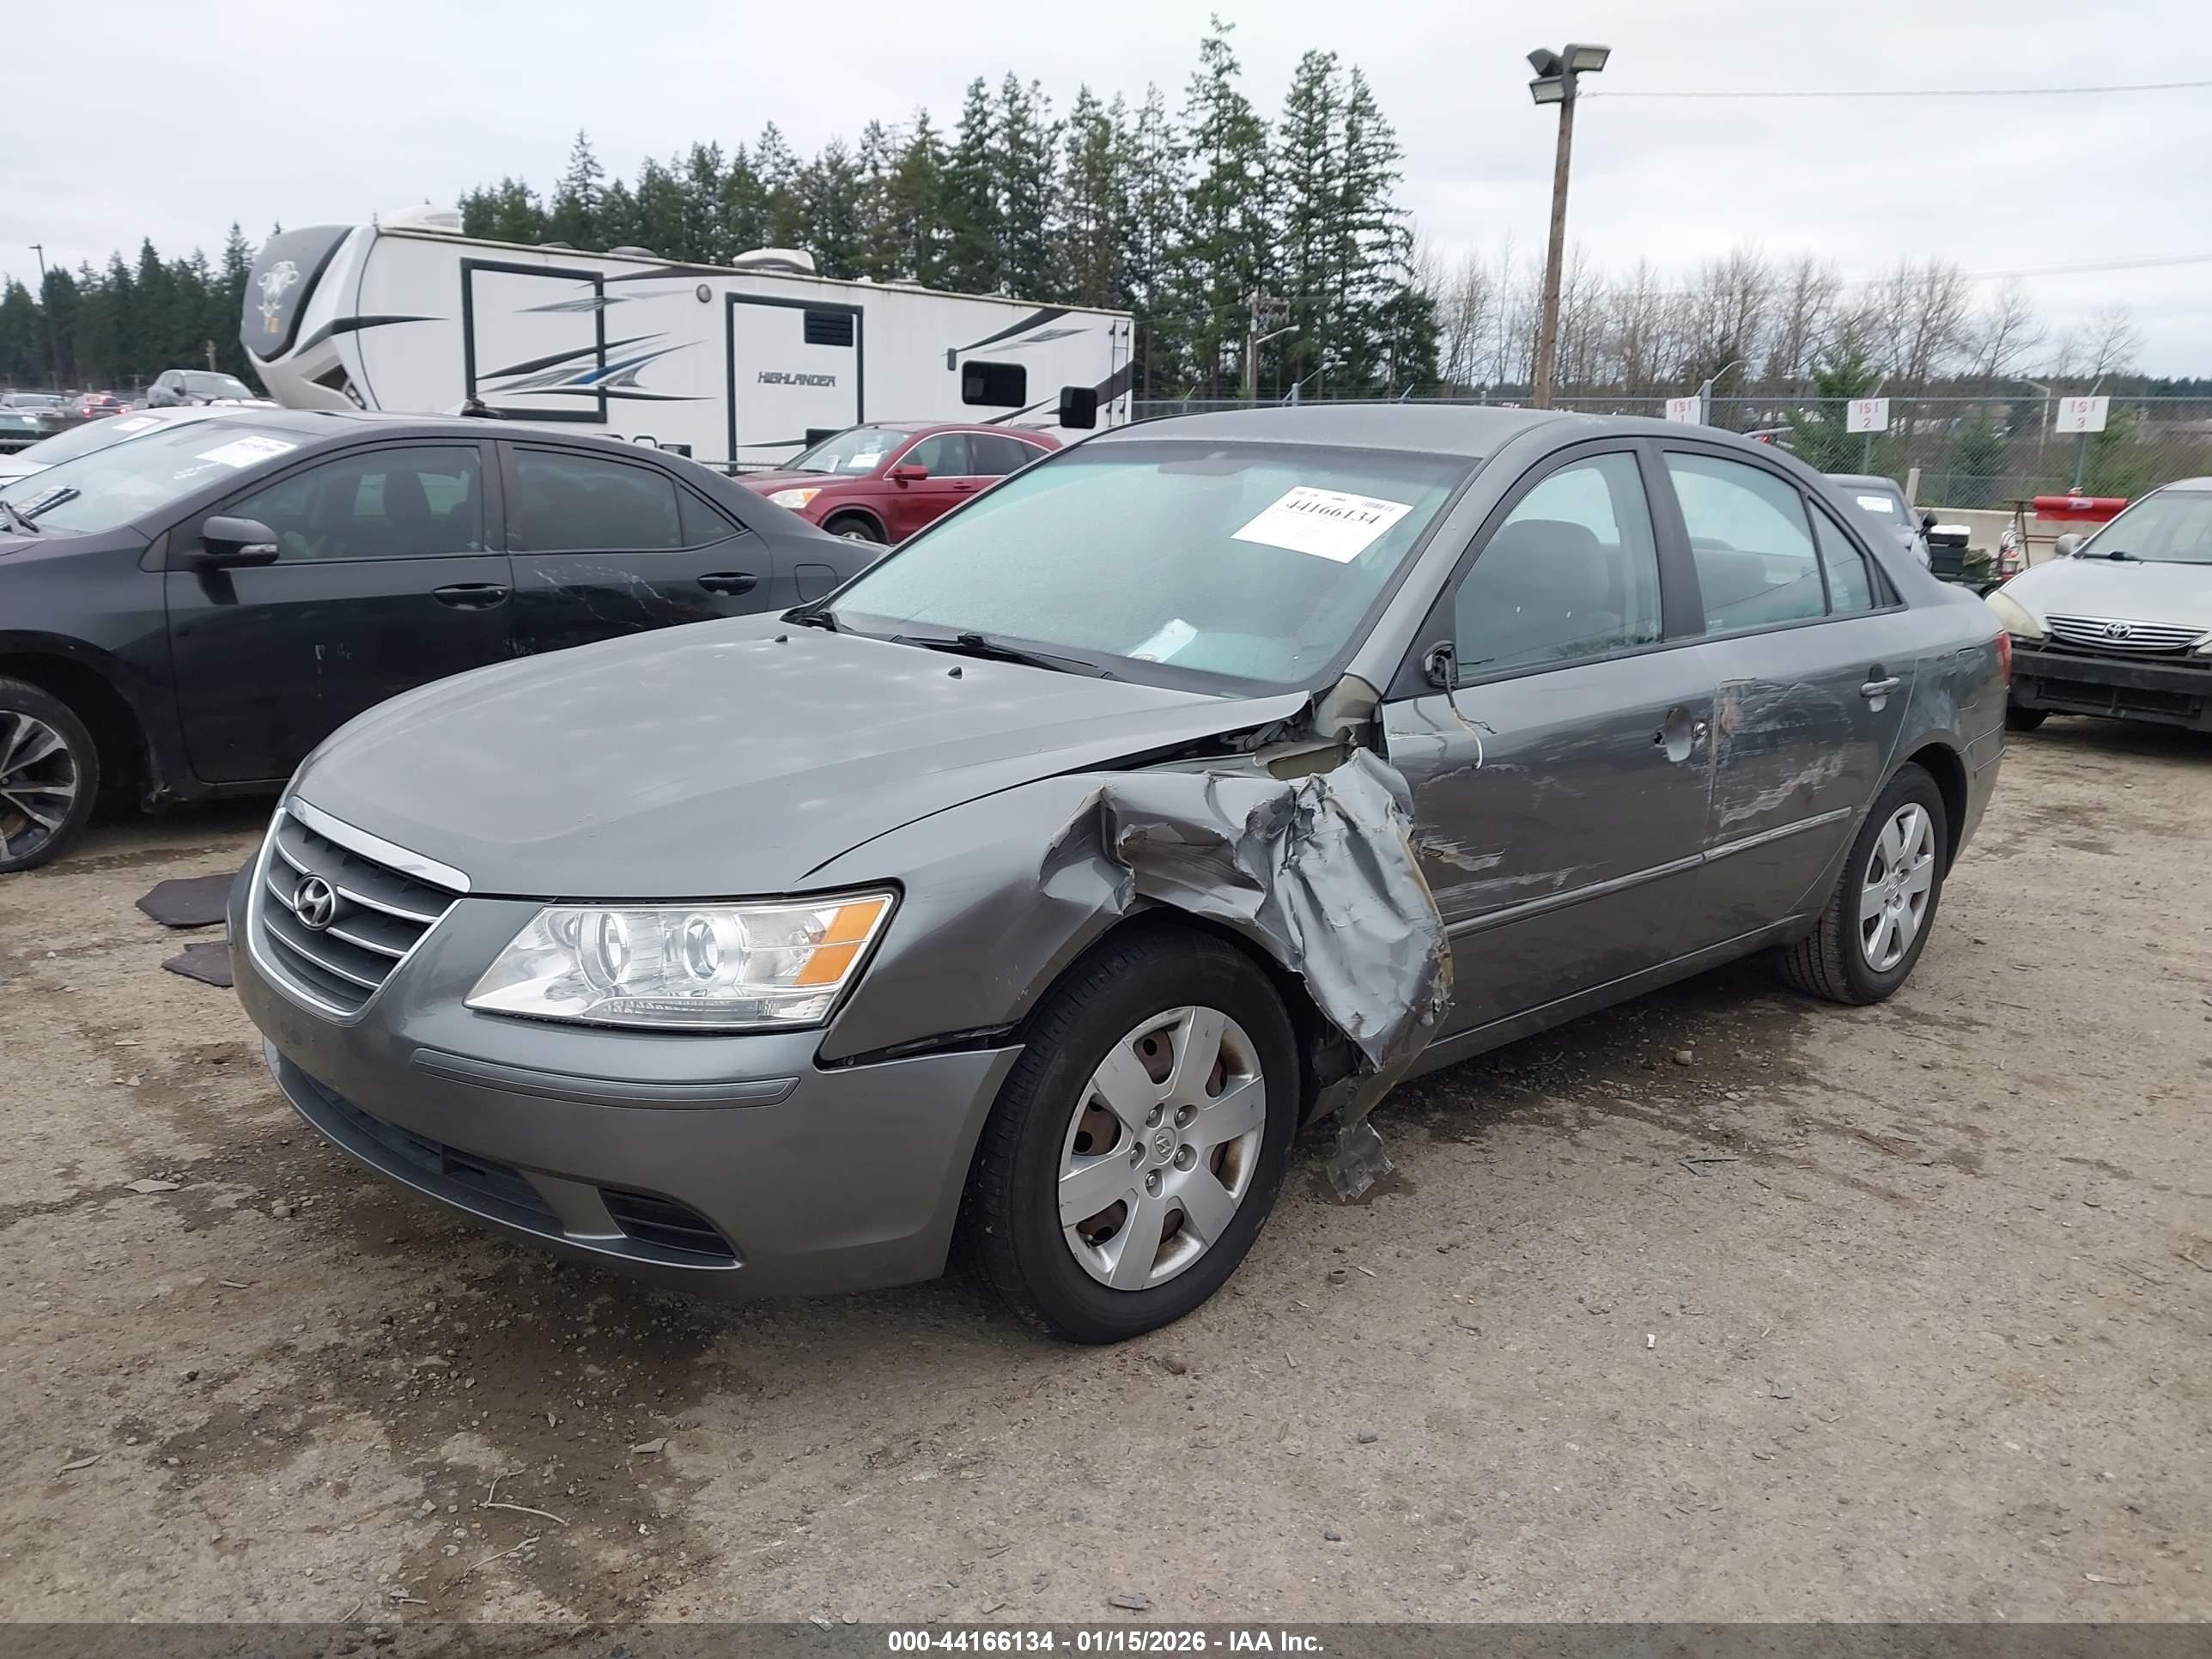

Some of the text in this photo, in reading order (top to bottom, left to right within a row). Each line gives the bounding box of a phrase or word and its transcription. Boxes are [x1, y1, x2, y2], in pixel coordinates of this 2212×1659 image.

[757, 371, 836, 387] HIGHLANDER
[1863, 417, 1871, 428] 2
[2076, 417, 2086, 428] 3
[1285, 500, 1382, 525] 44166134
